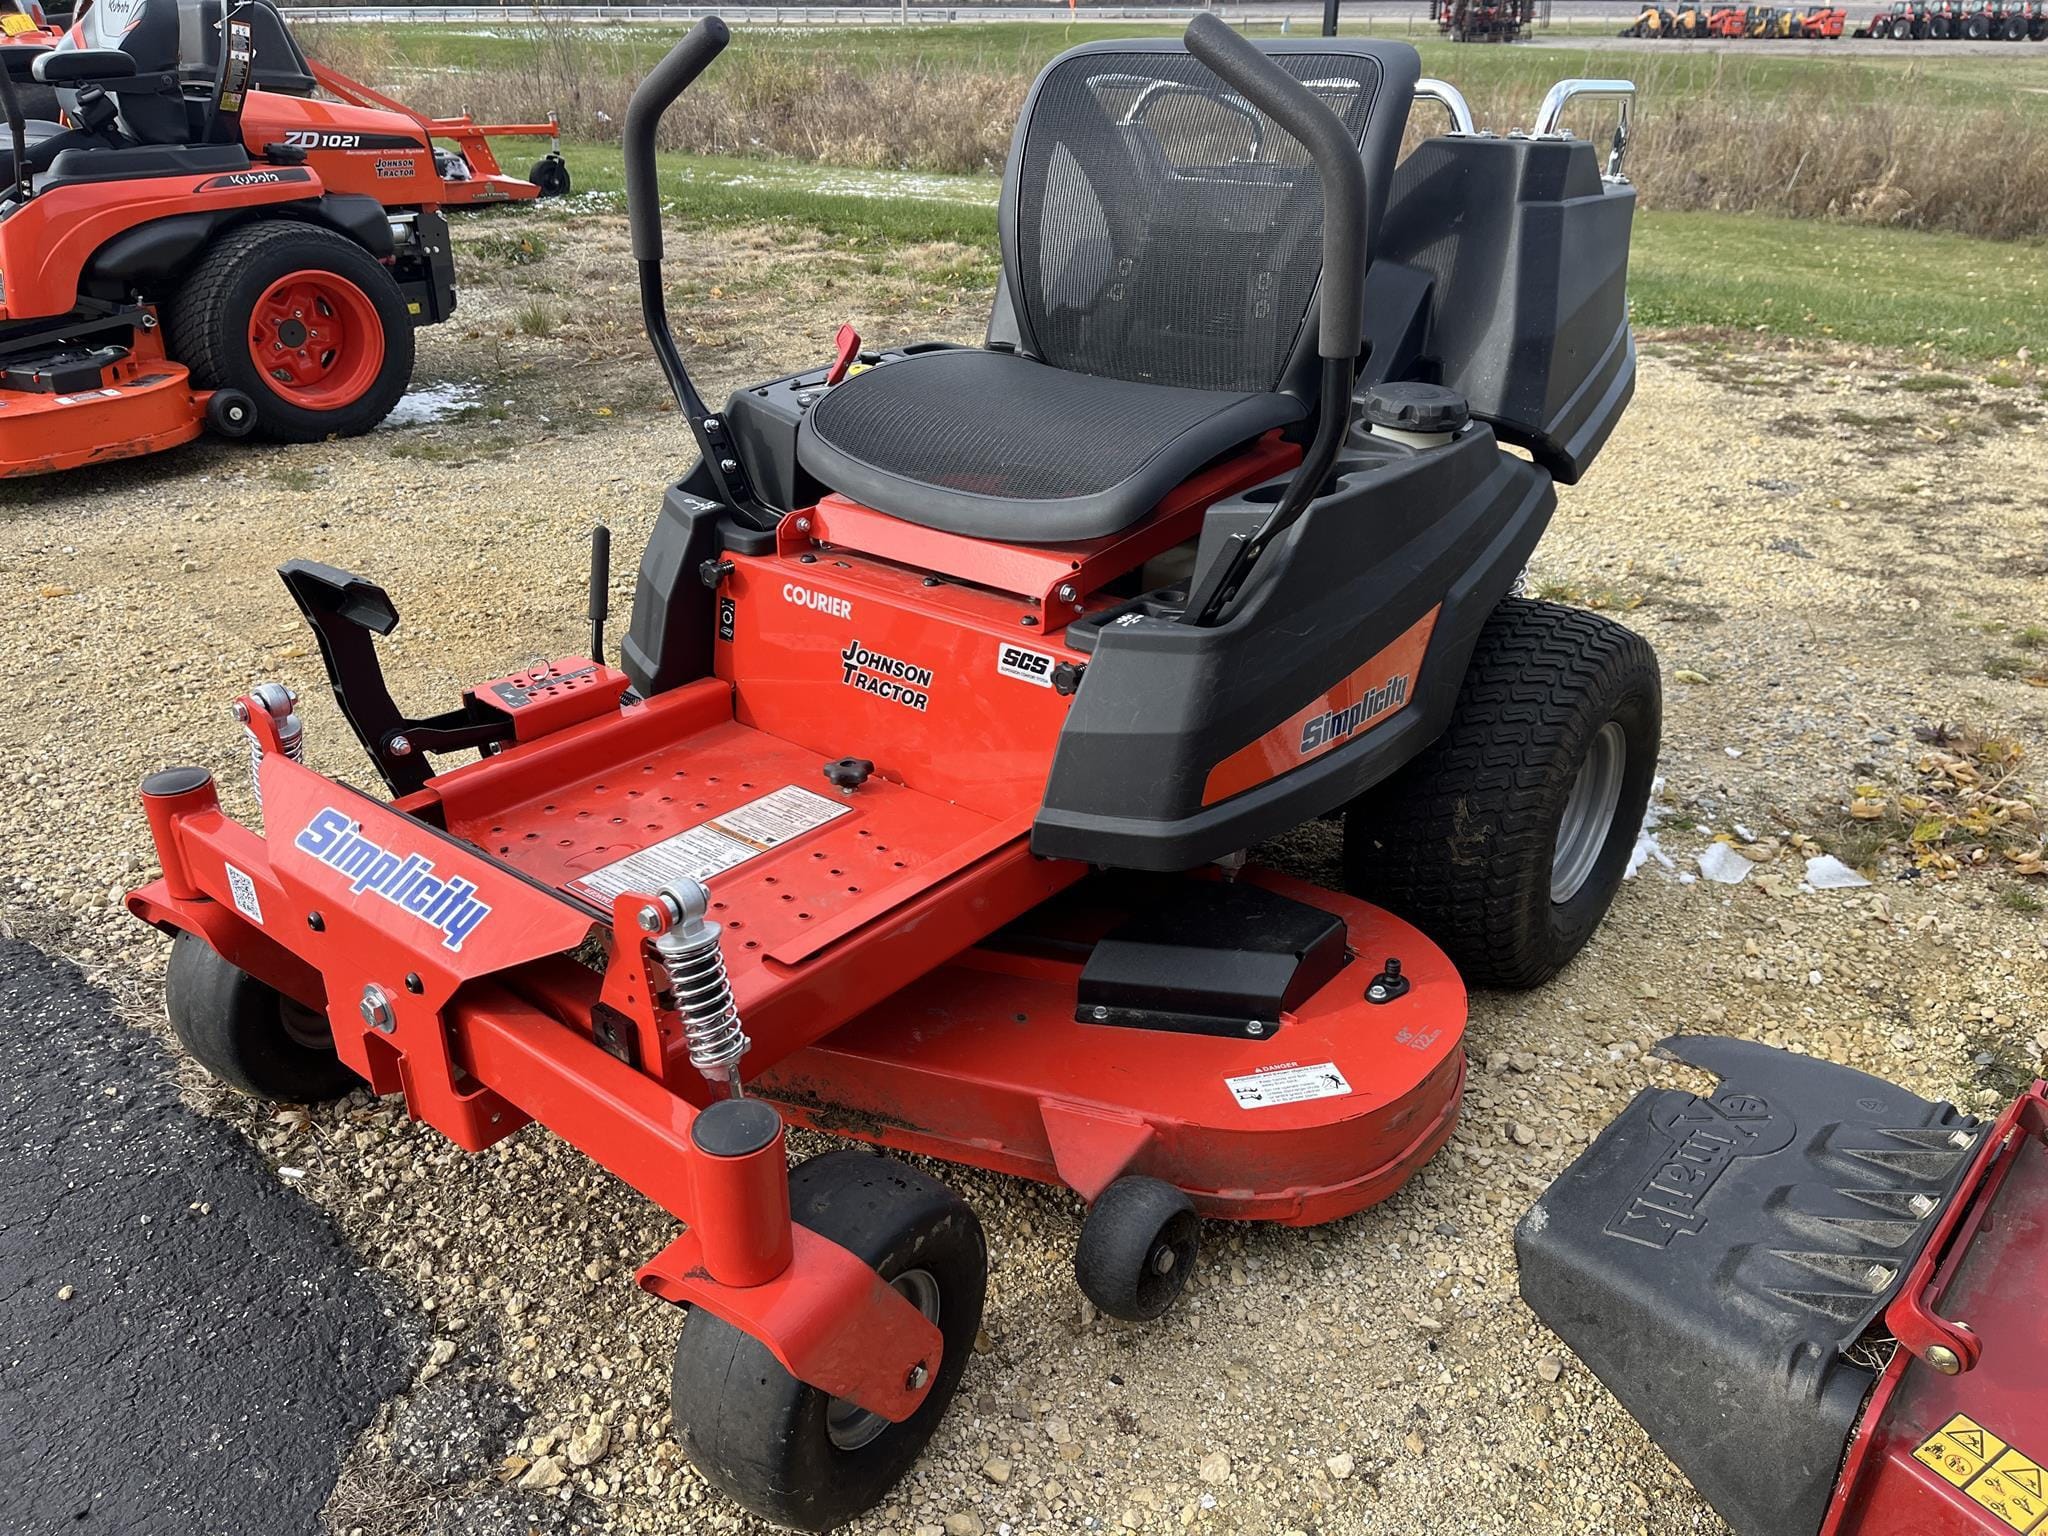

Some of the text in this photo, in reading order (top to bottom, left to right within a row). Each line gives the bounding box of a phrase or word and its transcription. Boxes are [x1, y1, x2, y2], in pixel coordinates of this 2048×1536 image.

[108, 0, 130, 13] Kubota
[375, 158, 415, 168] JOHNSON
[376, 168, 416, 179] TRACTOR
[229, 171, 280, 187] Kubota
[783, 584, 852, 620] COURIER
[842, 640, 933, 688] JOHNSON
[1002, 648, 1050, 675] SCS
[842, 662, 928, 712] TRACTOR
[1302, 674, 1408, 754] Simplicity
[295, 807, 491, 952] Simplicity
[1262, 1061, 1299, 1073] DANGER
